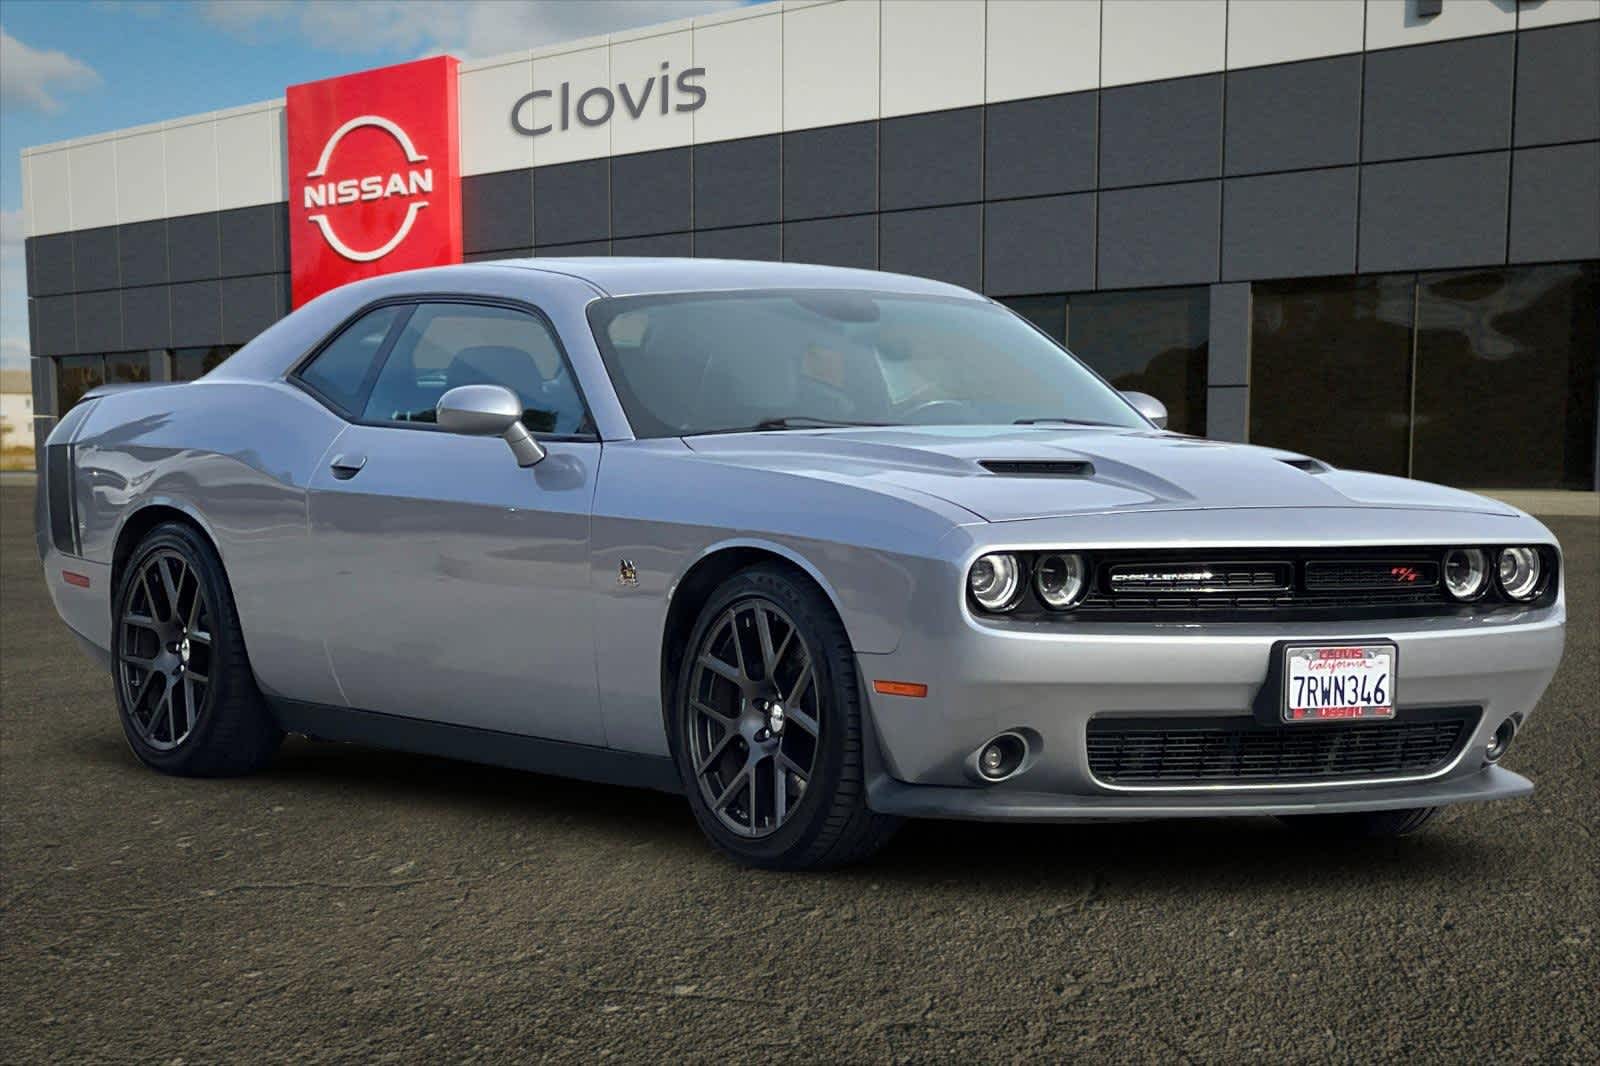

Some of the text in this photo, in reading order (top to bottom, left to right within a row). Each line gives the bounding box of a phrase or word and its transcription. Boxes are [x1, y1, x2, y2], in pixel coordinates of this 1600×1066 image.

[511, 61, 707, 136] Clovis
[304, 168, 433, 208] NISSAN
[1308, 658, 1373, 674] California
[1293, 673, 1387, 707] 7RWN346
